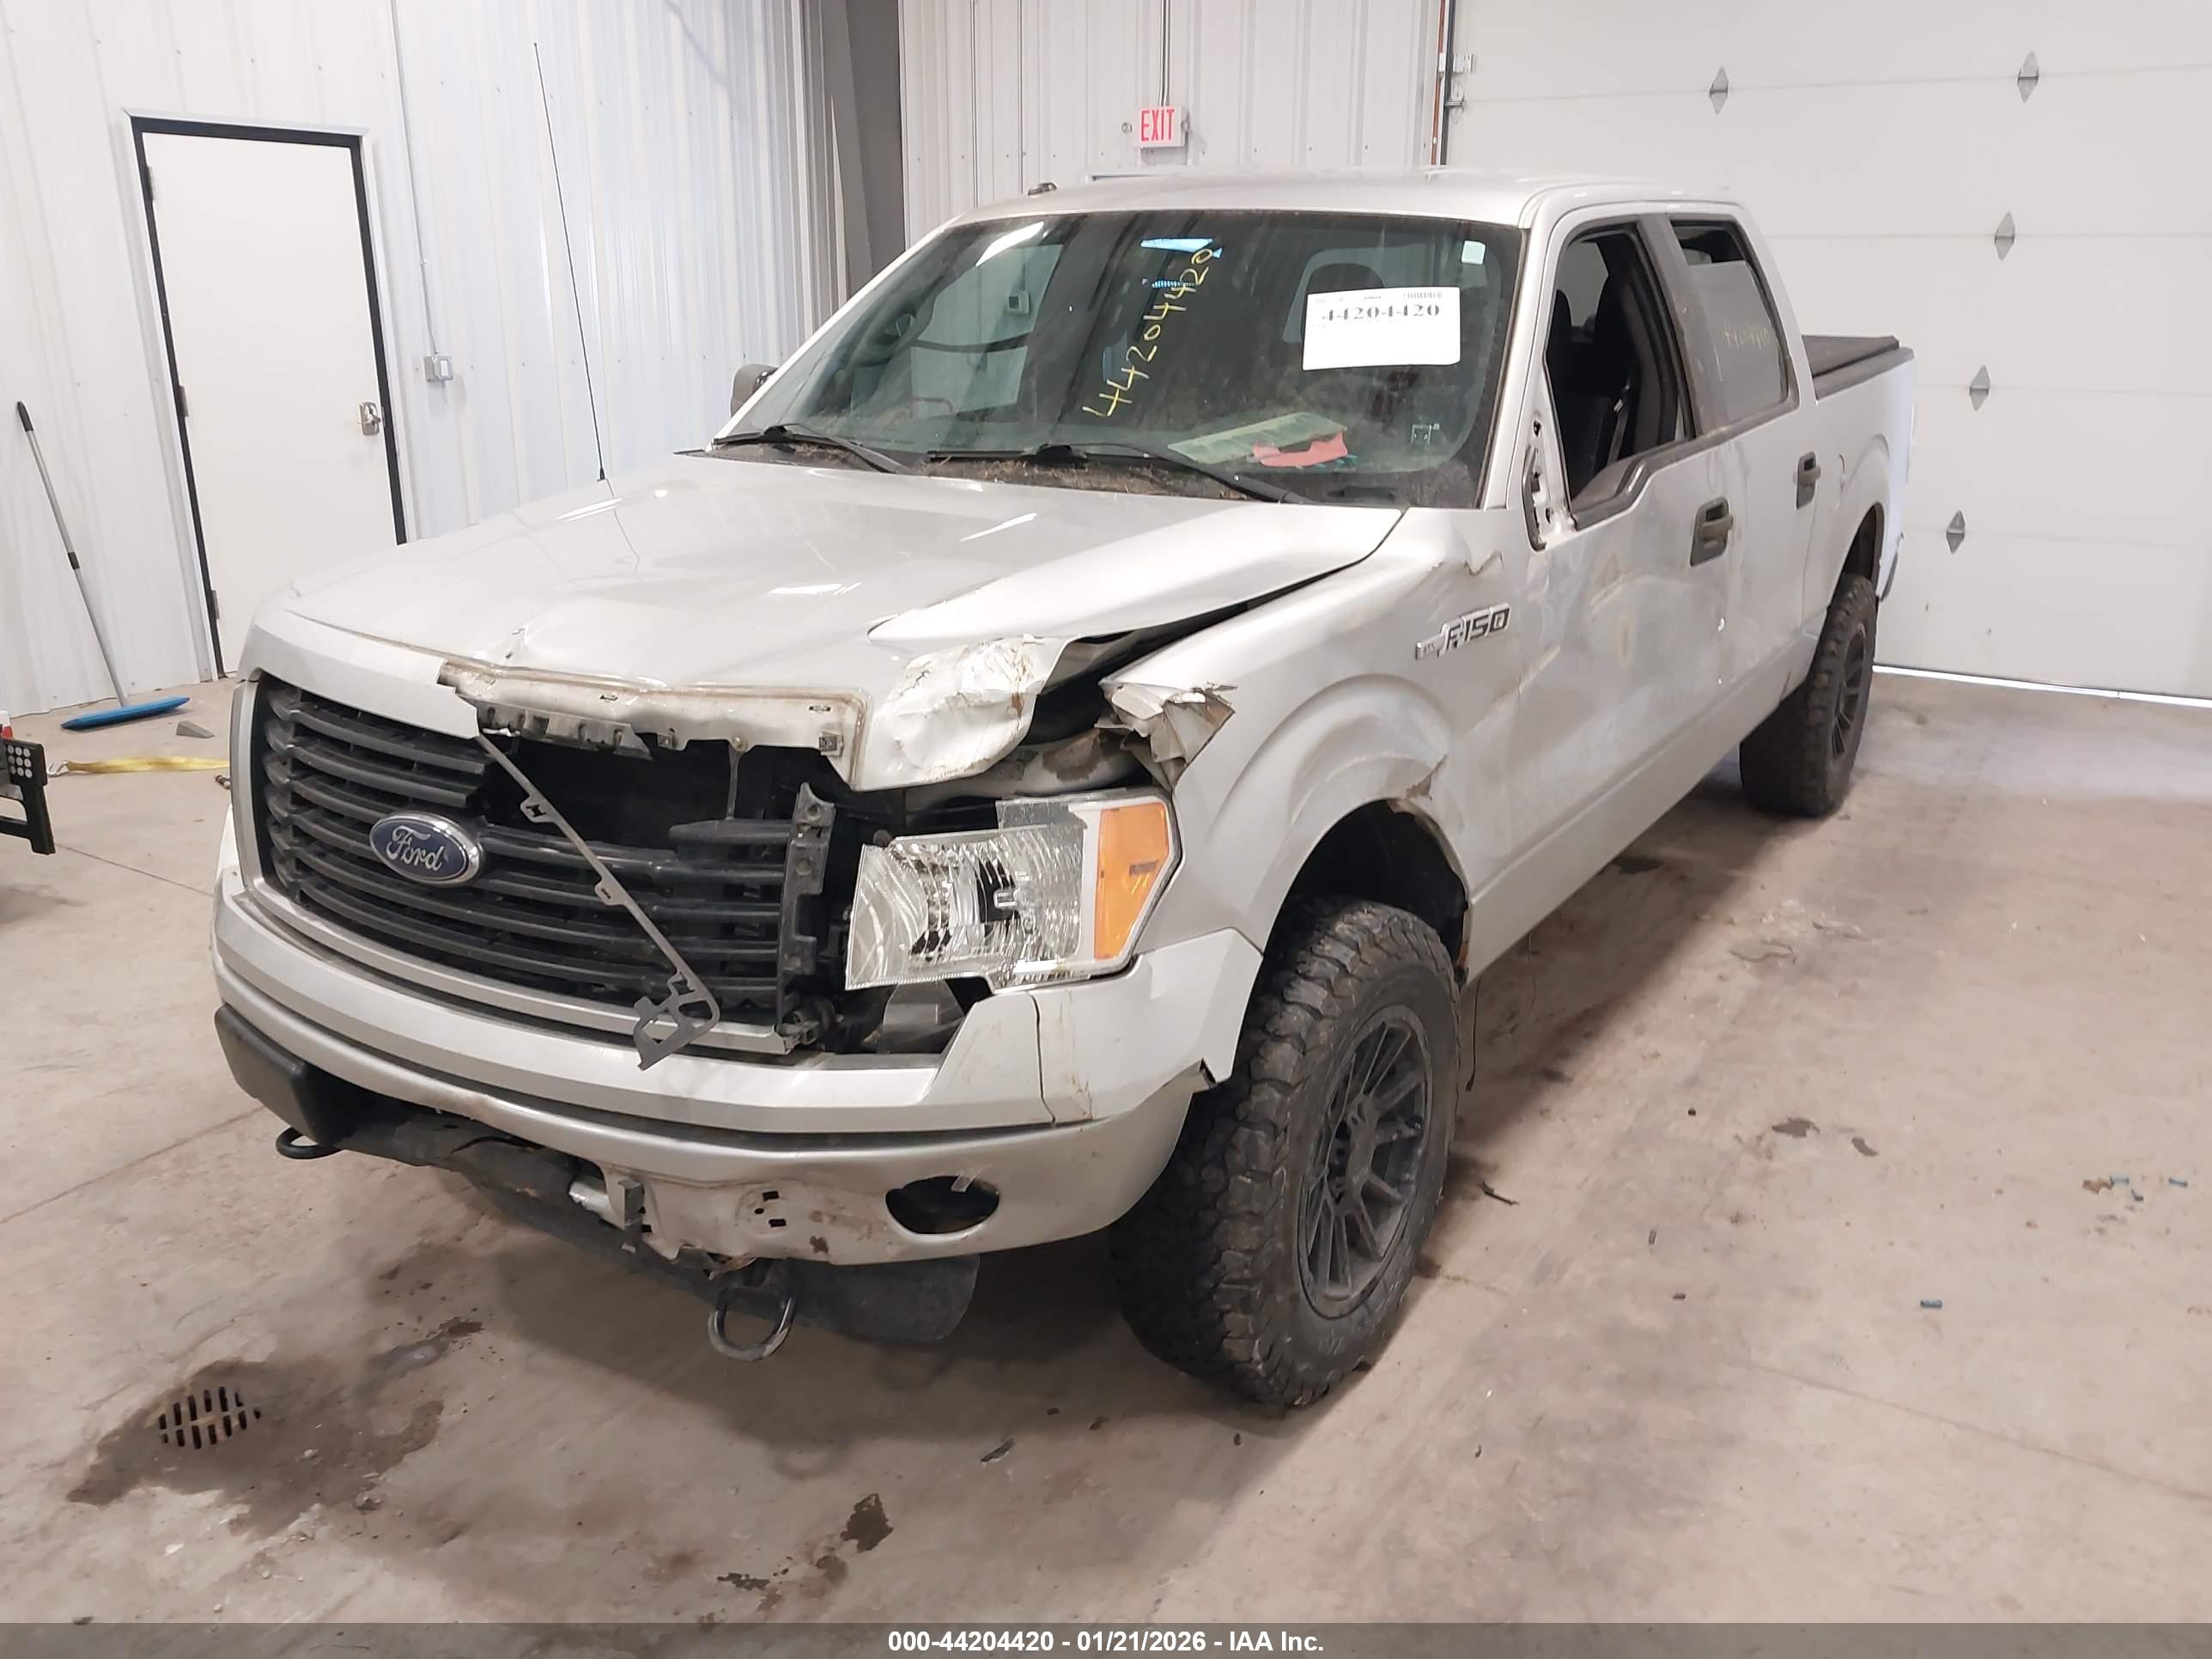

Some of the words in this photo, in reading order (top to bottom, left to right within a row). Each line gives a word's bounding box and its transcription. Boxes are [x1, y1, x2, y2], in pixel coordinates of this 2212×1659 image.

[1141, 109, 1175, 142] EXIT
[1082, 248, 1213, 416] 44204420
[1322, 304, 1440, 321] 44204420
[386, 825, 445, 872] Ford
